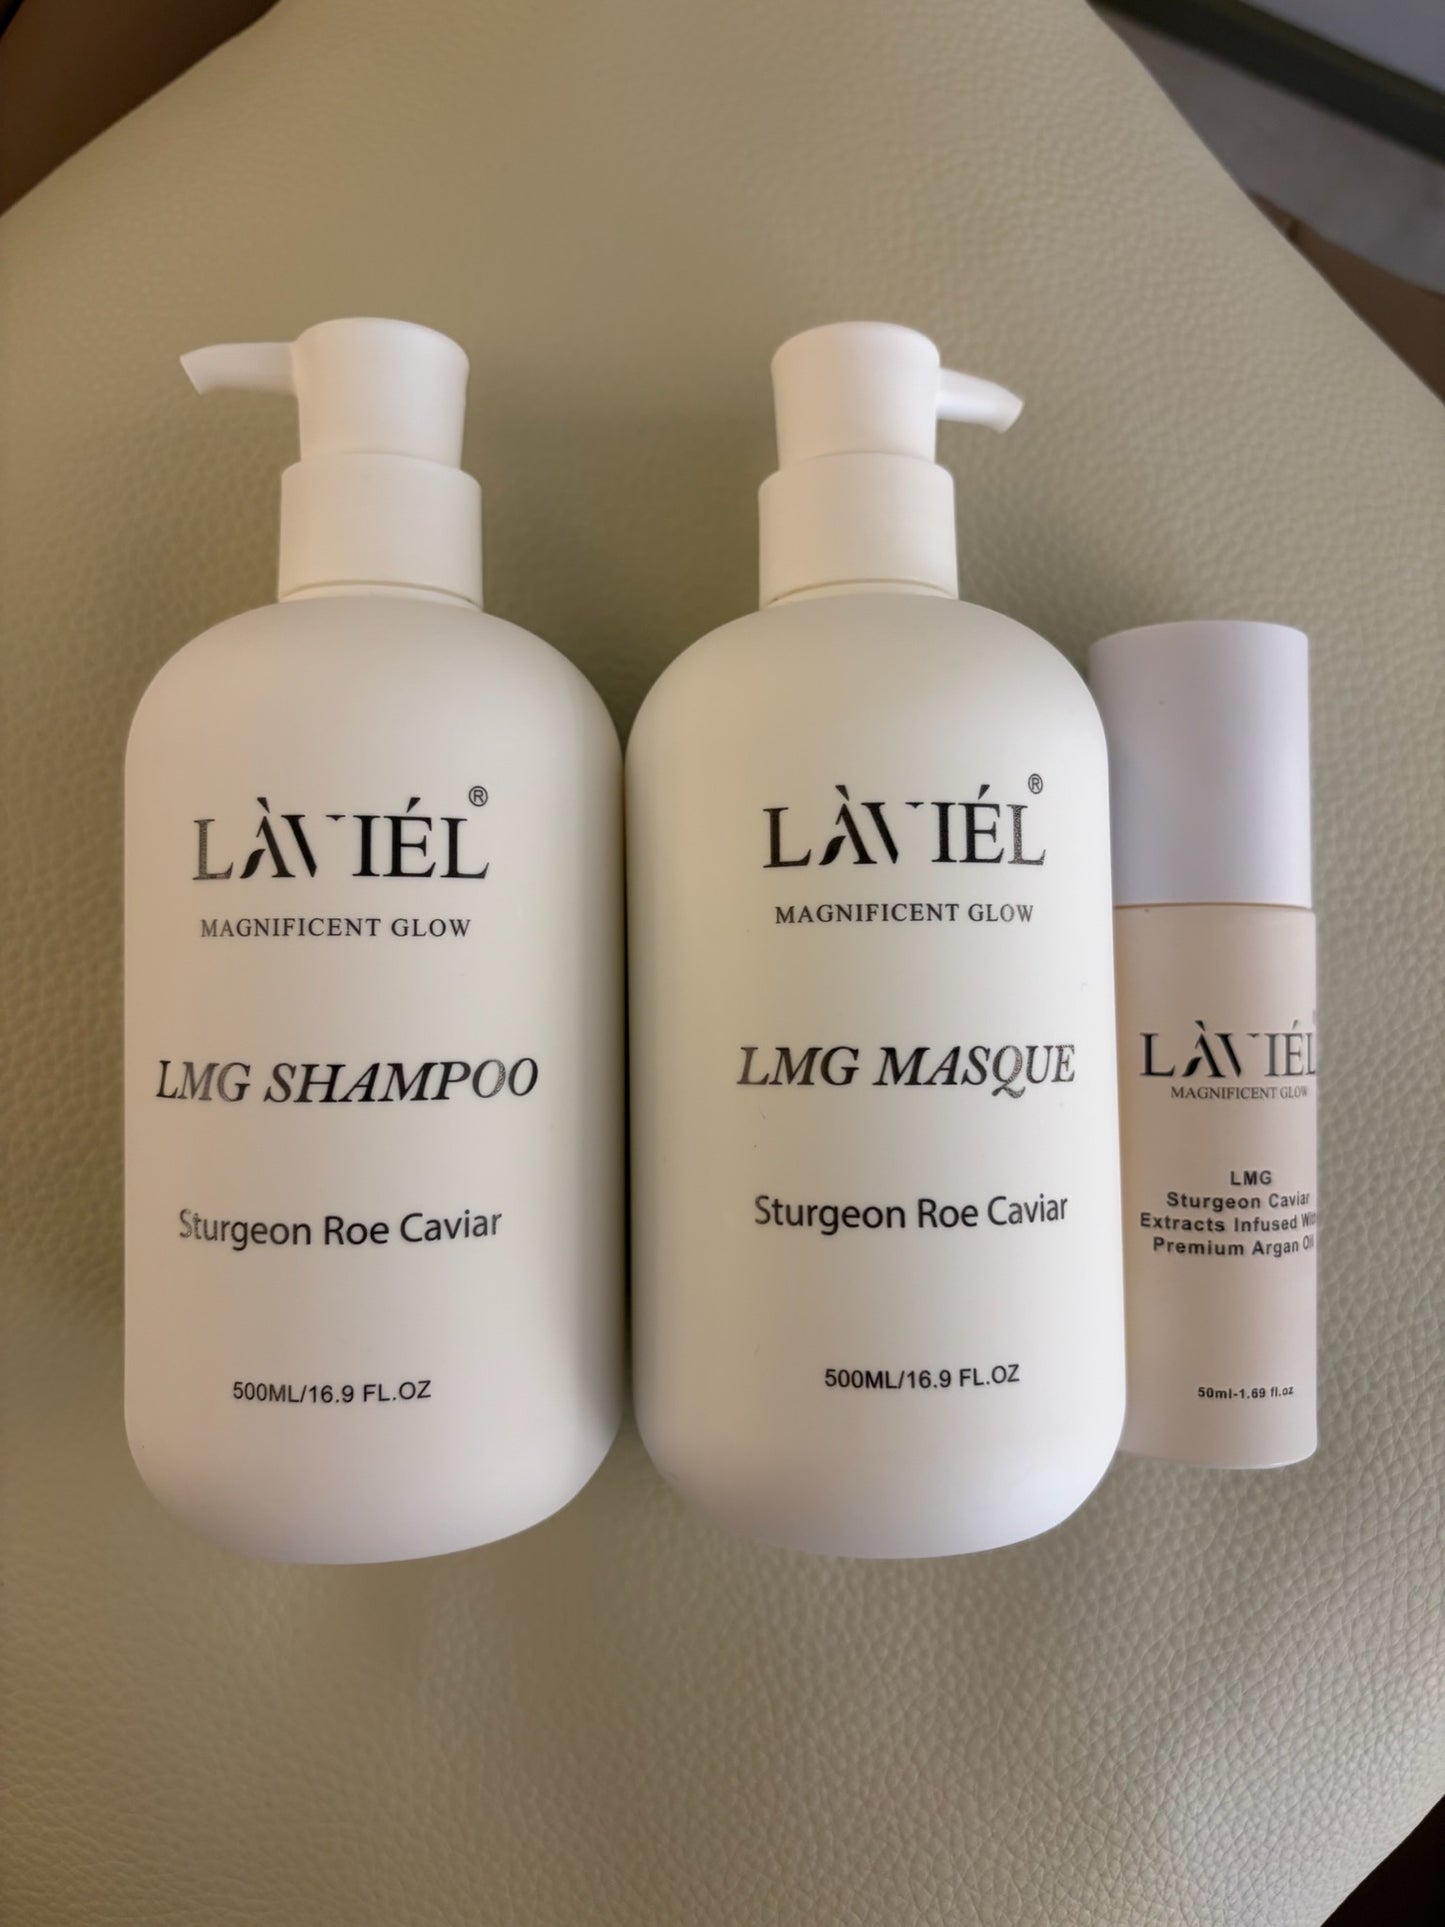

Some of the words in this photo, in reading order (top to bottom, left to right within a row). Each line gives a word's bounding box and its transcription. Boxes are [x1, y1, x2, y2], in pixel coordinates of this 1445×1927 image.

[775, 902, 960, 924] MAGNIFICENT
[968, 903, 1034, 922] GLOW
[201, 917, 381, 938] MAGNIFICENT
[391, 917, 472, 937] GLOW
[156, 1059, 252, 1103] LMG
[263, 1057, 539, 1104] SHAMPOO
[736, 1045, 860, 1087] LMG
[871, 1043, 1077, 1100] MASQUE
[1170, 1086, 1277, 1100] MAGNIFICENT
[1280, 1085, 1308, 1100] GLOW
[1230, 1170, 1273, 1186] LMG
[1166, 1191, 1261, 1213] Sturgeon
[1268, 1190, 1310, 1209] Caviar
[754, 1194, 906, 1237] Sturgeon
[917, 1198, 979, 1229] Roe
[987, 1193, 1069, 1226] Caviar
[1140, 1212, 1226, 1233] Extracts
[1234, 1214, 1298, 1233] Infused
[178, 1208, 312, 1252] Sturgeon
[324, 1215, 390, 1246] Roe
[400, 1209, 503, 1243] Caviar
[1153, 1236, 1245, 1257] Premium
[1251, 1240, 1299, 1259] Argan
[824, 1367, 952, 1390] 500ML/16.9
[959, 1364, 1021, 1388] FL.OZ
[232, 1381, 355, 1404] 500ML/16.9
[362, 1379, 432, 1402] FL.OZ
[1197, 1386, 1267, 1400] 50ml-1.69
[1269, 1385, 1295, 1398] fl.oz
